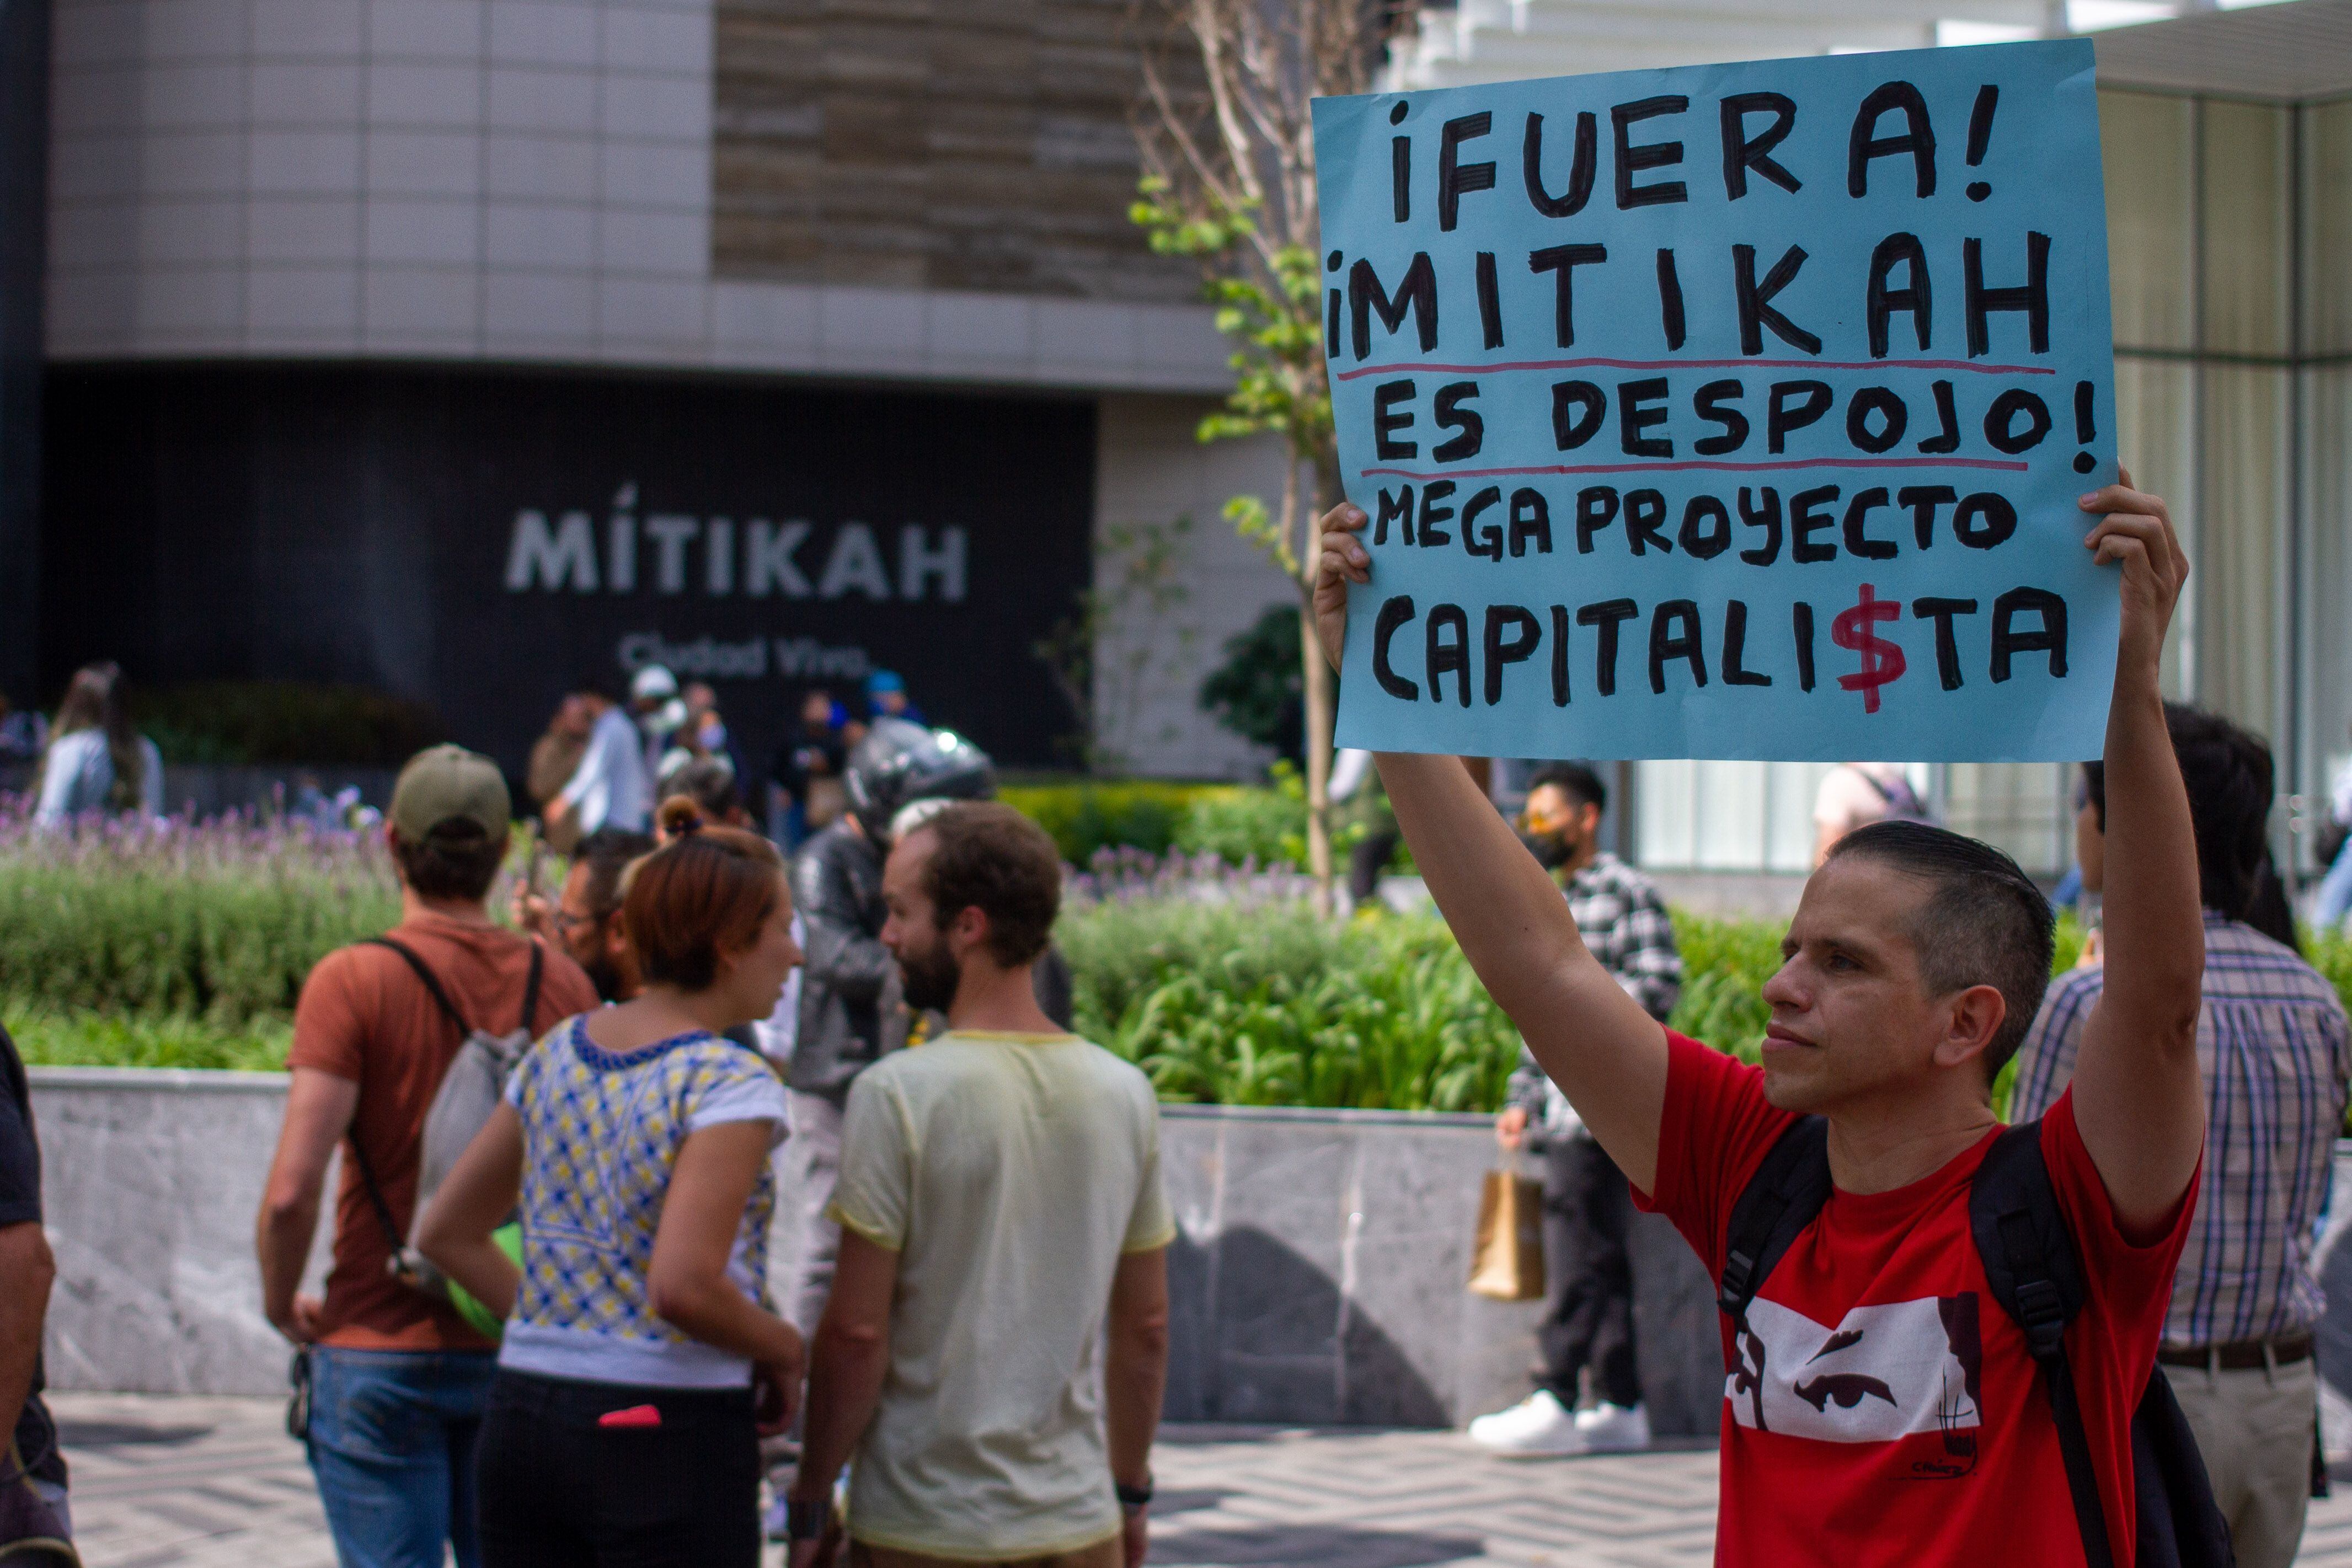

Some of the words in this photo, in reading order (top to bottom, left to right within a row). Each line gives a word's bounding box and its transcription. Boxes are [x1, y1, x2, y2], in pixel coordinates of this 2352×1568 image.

[1390, 81, 2000, 232] ¡FUERA!
[1328, 231, 2051, 361] ¡MITIKAH
[1374, 379, 1484, 463] ES
[1552, 377, 2097, 475] DESPOJO!
[1374, 480, 1552, 563] MEGA
[1576, 484, 2018, 567] PROYECTO
[1373, 583, 2068, 714] CAPITALI$TA
